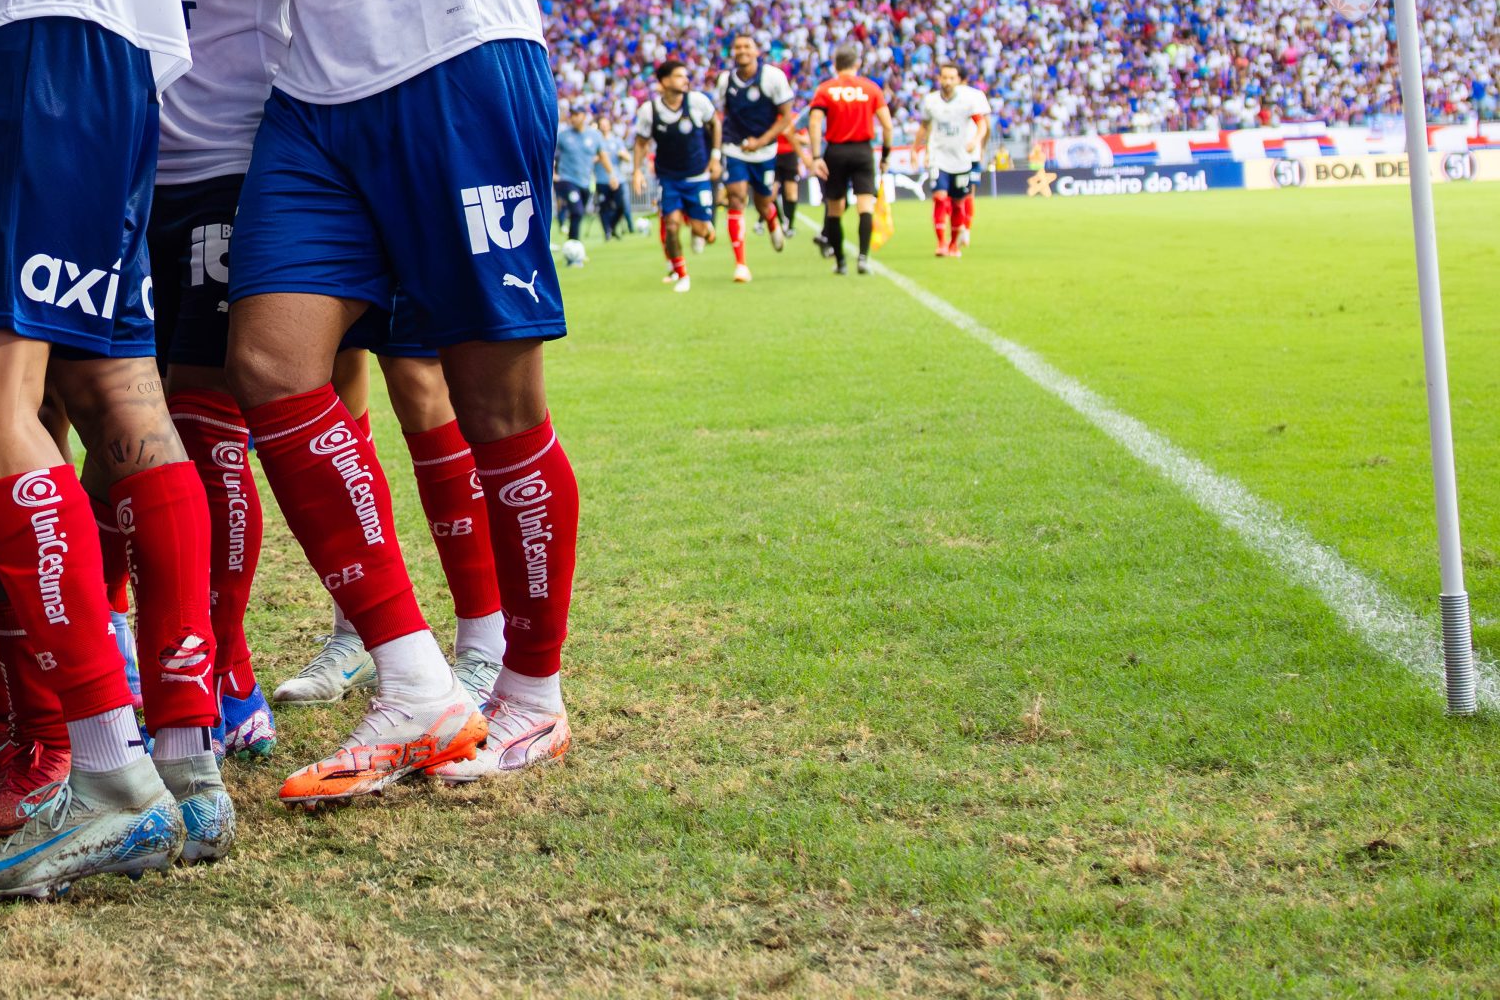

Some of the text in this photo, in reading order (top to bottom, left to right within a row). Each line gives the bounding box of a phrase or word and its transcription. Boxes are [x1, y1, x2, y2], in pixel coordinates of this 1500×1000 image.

[828, 86, 869, 102] TCL
[1276, 159, 1300, 187] 51
[1315, 160, 1411, 181] BOA IDE
[1449, 152, 1473, 180] 51
[492, 181, 532, 201] Brasil
[1056, 169, 1208, 196] Cruzeiro do Sul
[331, 448, 386, 547] UniCesumar
[222, 472, 250, 573] UniCesumar
[516, 504, 553, 600] UniCesumar
[30, 509, 70, 626] UniCesumar
